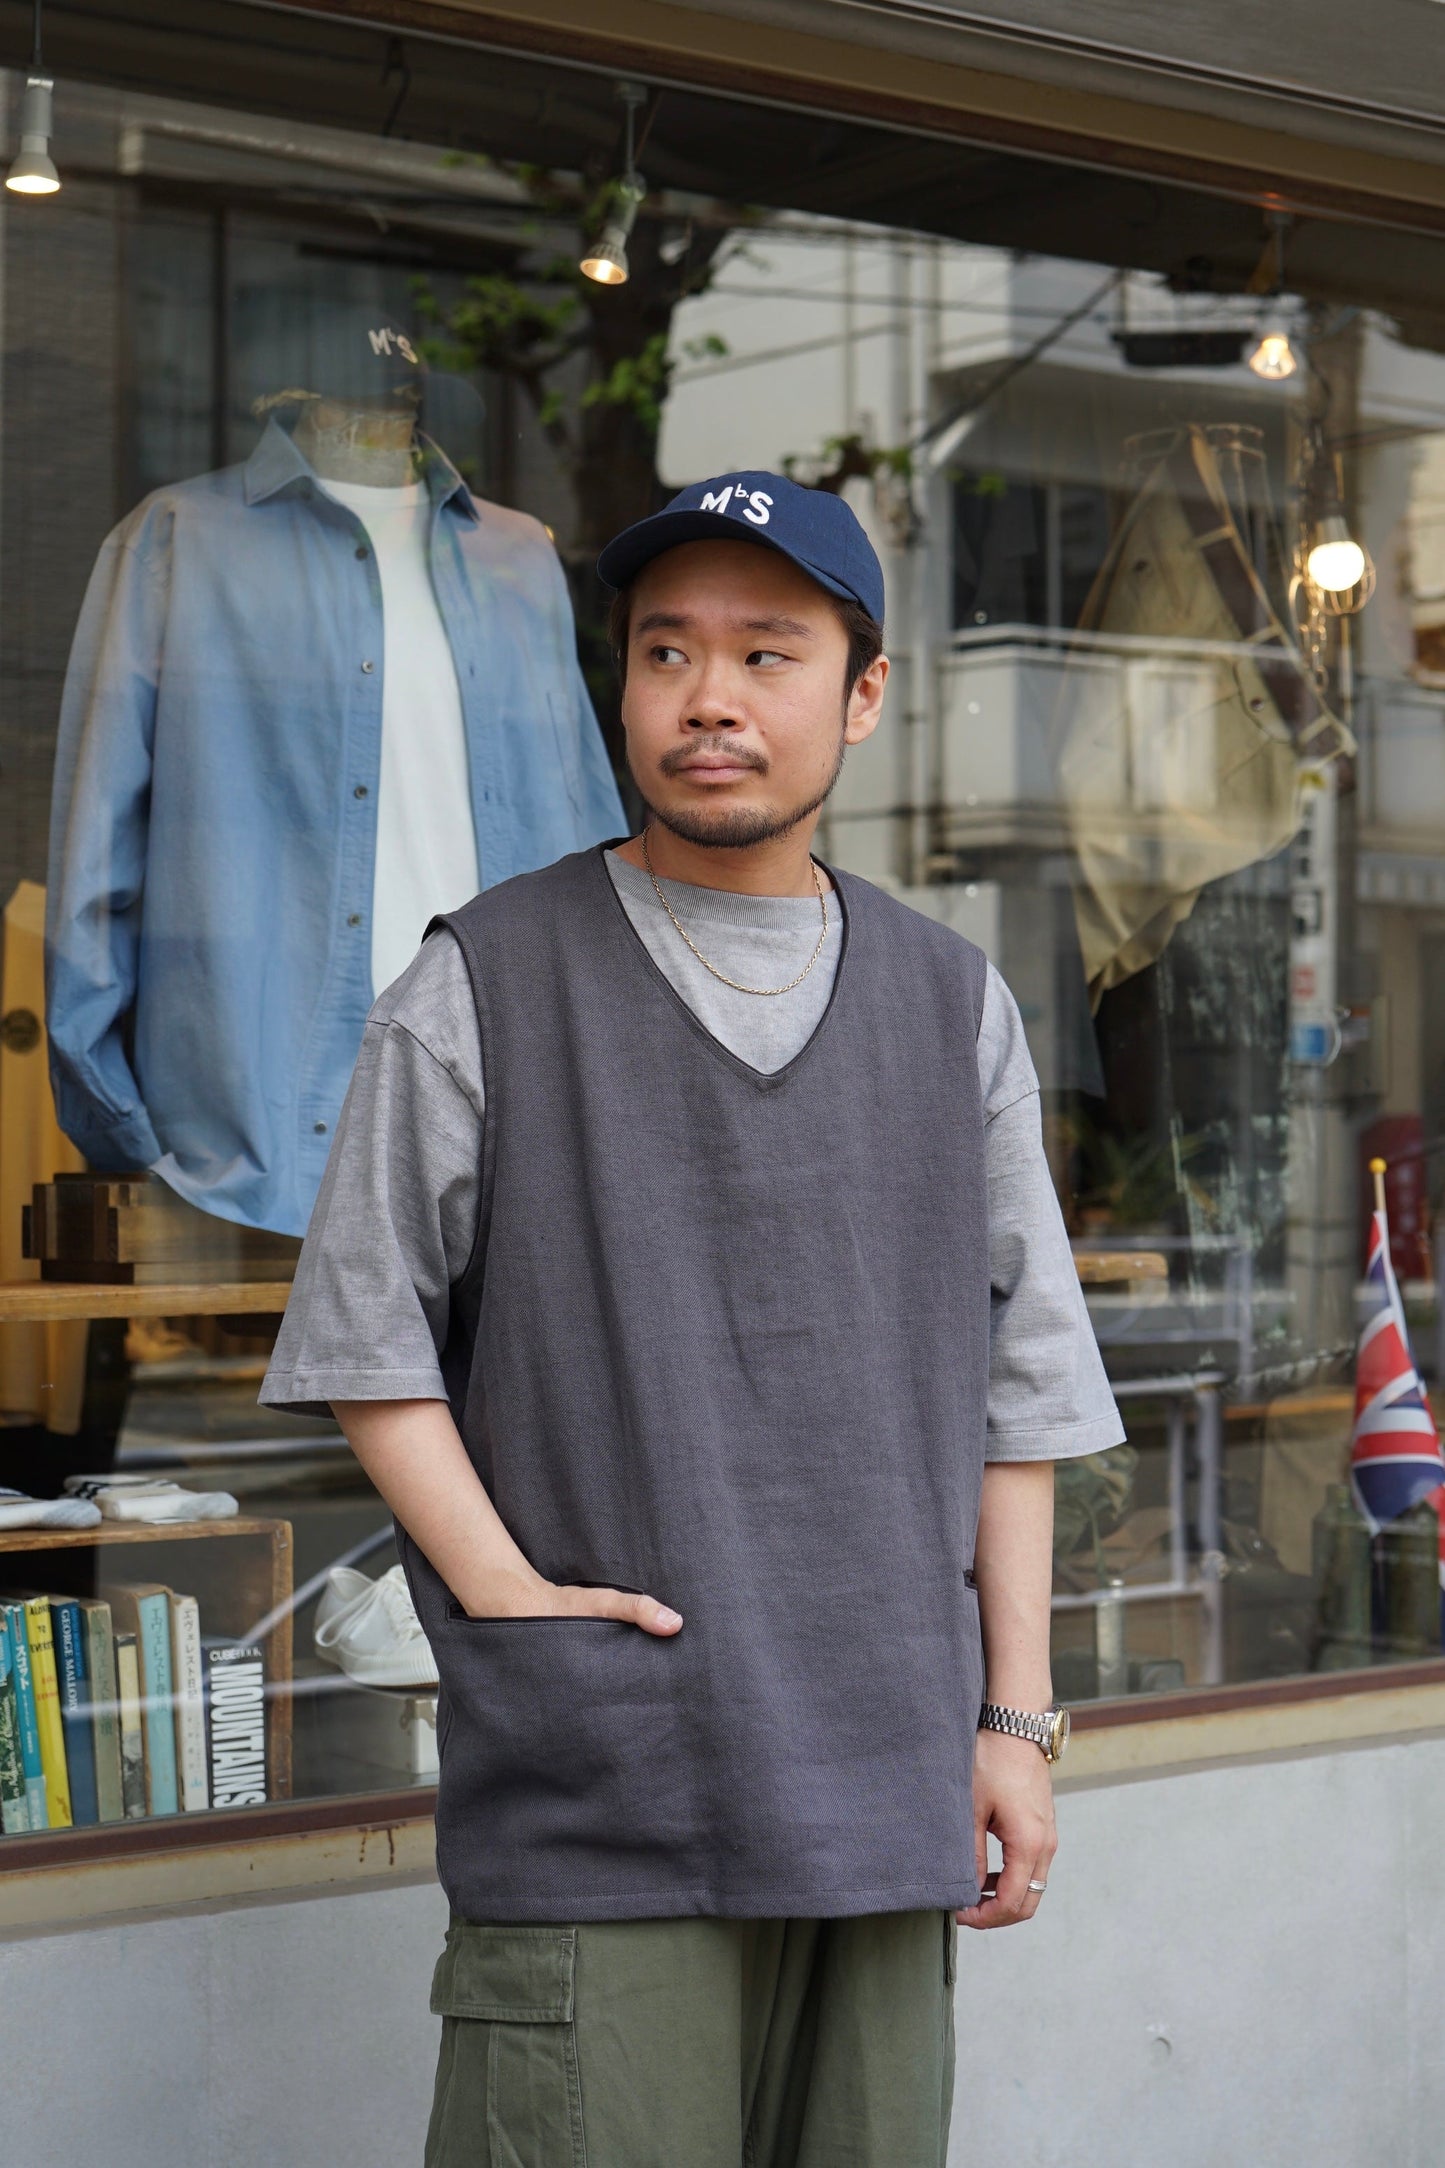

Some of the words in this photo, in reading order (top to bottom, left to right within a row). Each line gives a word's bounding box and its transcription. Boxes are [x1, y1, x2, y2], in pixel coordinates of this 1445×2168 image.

[60, 1608, 74, 1656] GEORGE
[65, 1657, 79, 1712] MALLORY
[210, 1662, 267, 1808] MOUNTAINS
